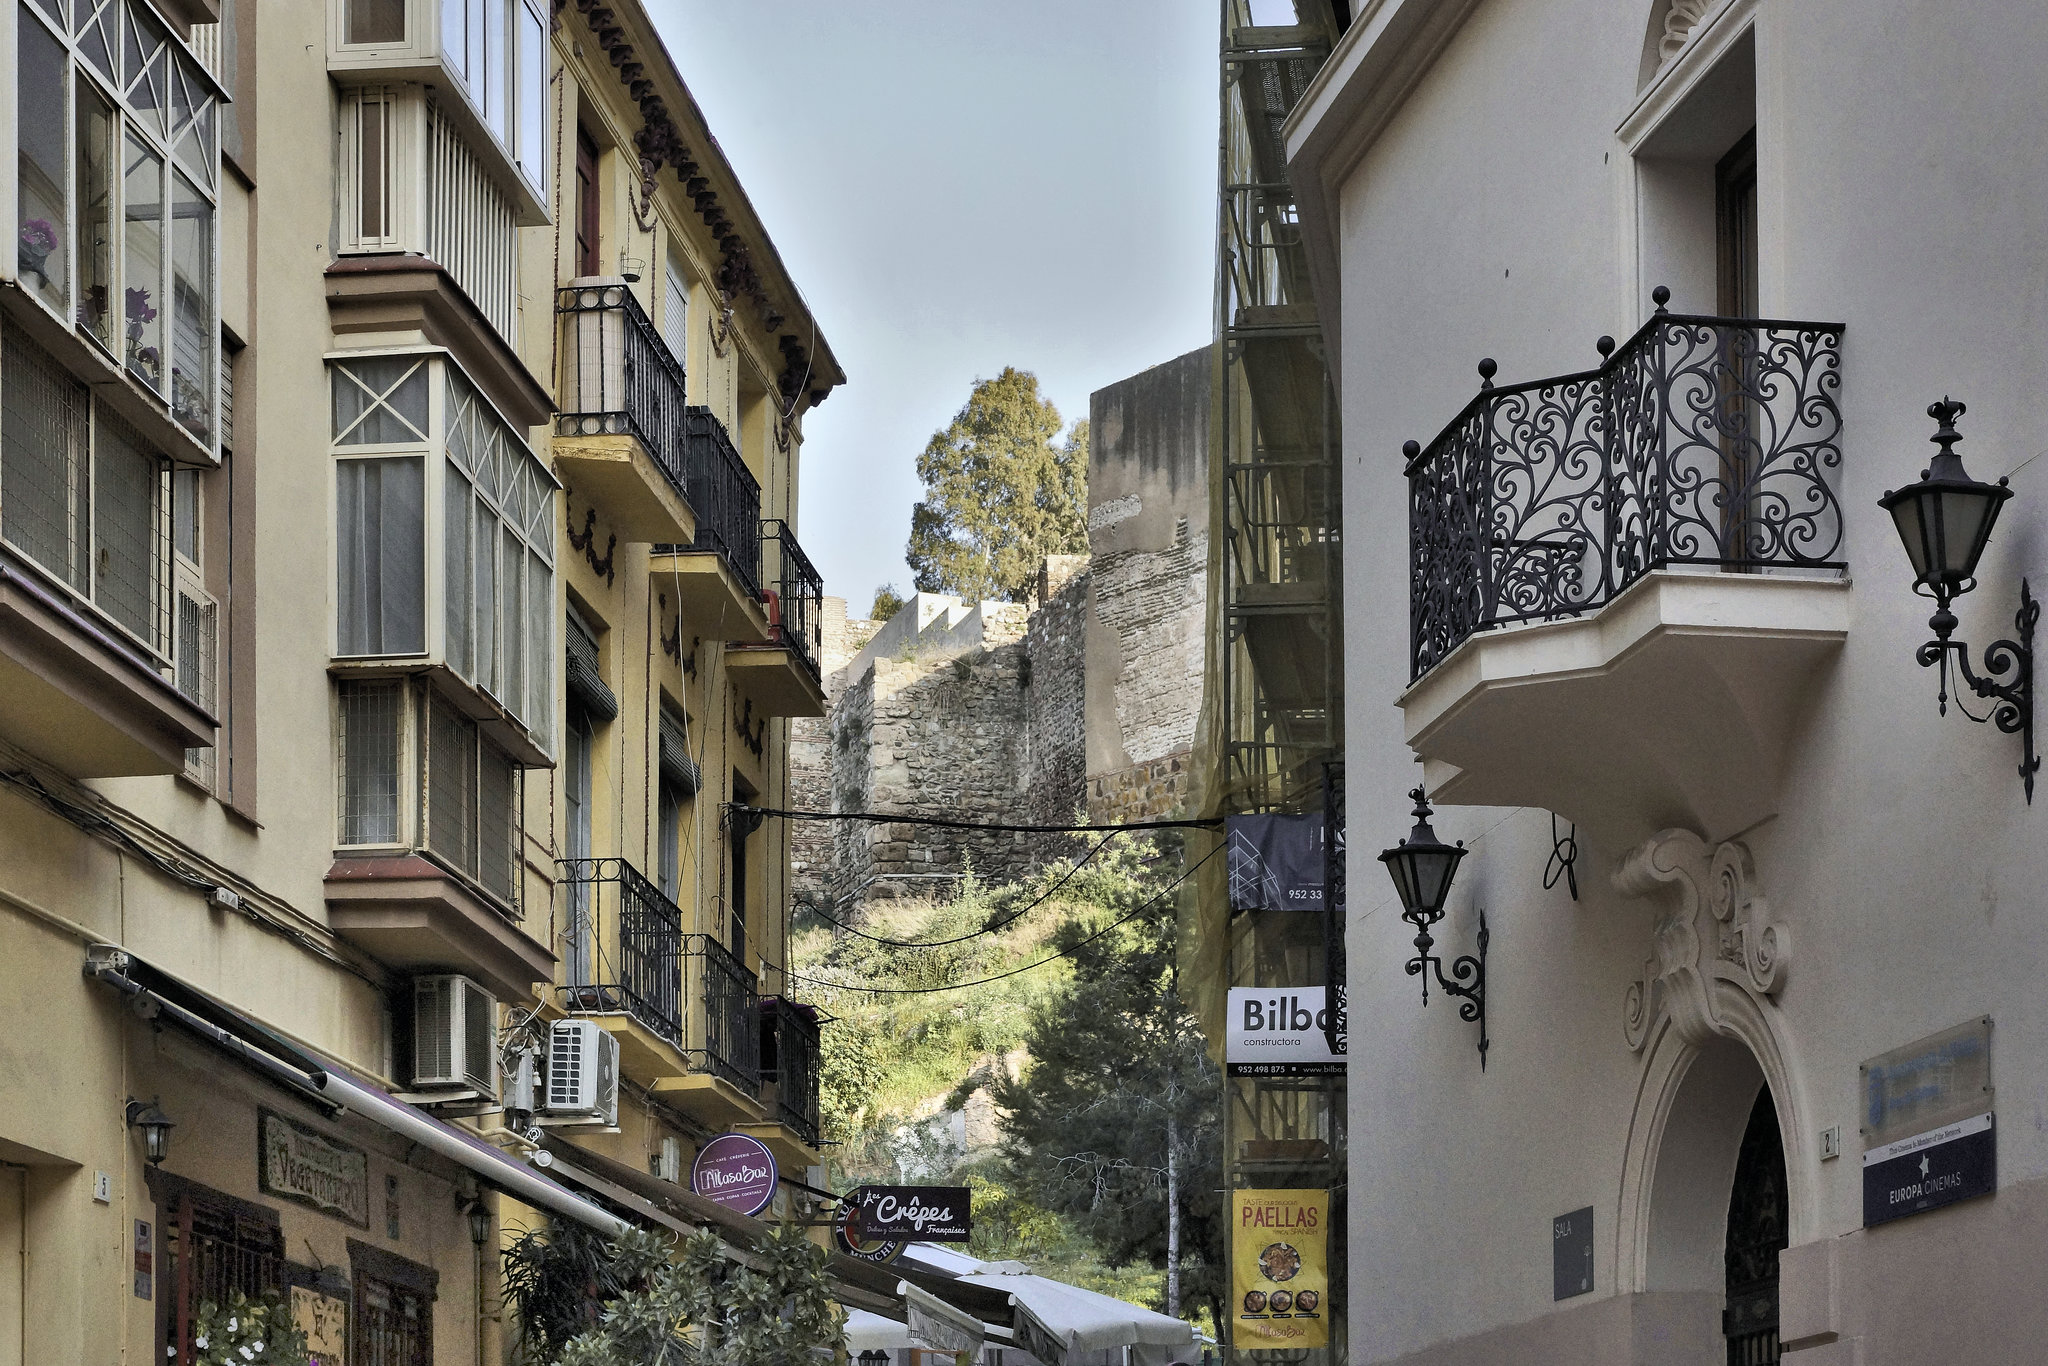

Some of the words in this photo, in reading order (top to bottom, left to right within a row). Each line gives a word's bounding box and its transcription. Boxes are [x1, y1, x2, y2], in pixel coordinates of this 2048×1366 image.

[1288, 889, 1307, 900] 952
[1243, 1038, 1301, 1046] constructora
[1237, 1065, 1253, 1074] 952
[1254, 1065, 1269, 1074] 498
[1270, 1065, 1286, 1074] 875
[1825, 1133, 1830, 1153] 2
[101, 1177, 107, 1196] 5
[1889, 1184, 1923, 1205] EUROPA
[1924, 1171, 1961, 1195] CINEMAS
[876, 1195, 953, 1231] Crêpes
[1242, 1206, 1318, 1227] PAELLAS
[925, 1224, 967, 1236] Françaises
[1555, 1220, 1572, 1239] SALA
